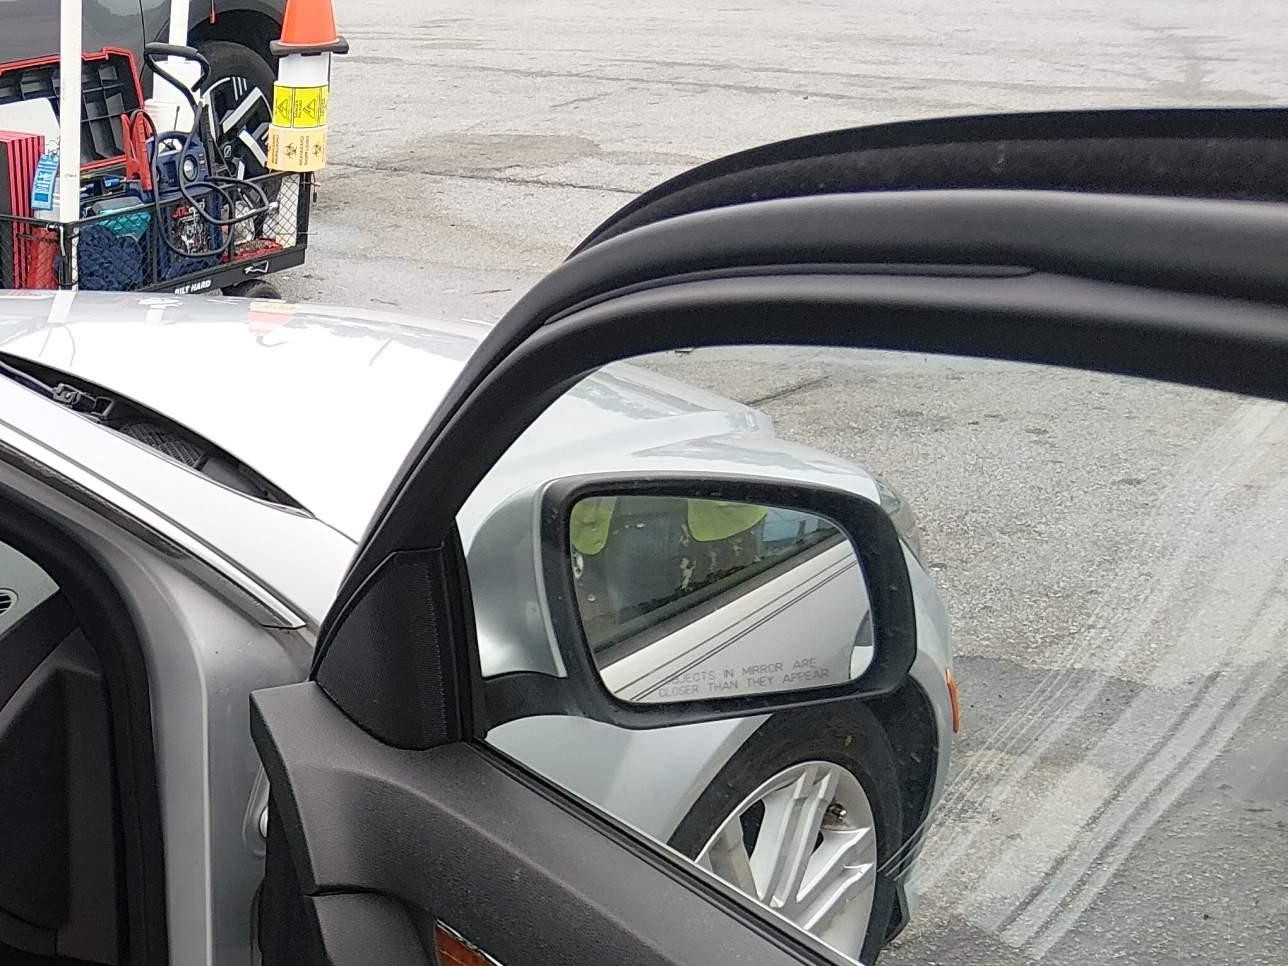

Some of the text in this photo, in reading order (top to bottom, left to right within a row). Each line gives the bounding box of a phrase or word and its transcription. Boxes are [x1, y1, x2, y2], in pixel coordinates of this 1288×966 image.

[190, 279, 212, 293] HARD
[723, 668, 734, 678] IN
[741, 662, 784, 676] MIRROR
[792, 657, 817, 670] ARE
[658, 668, 830, 698] CLOSER THAN THEY APPEAR
